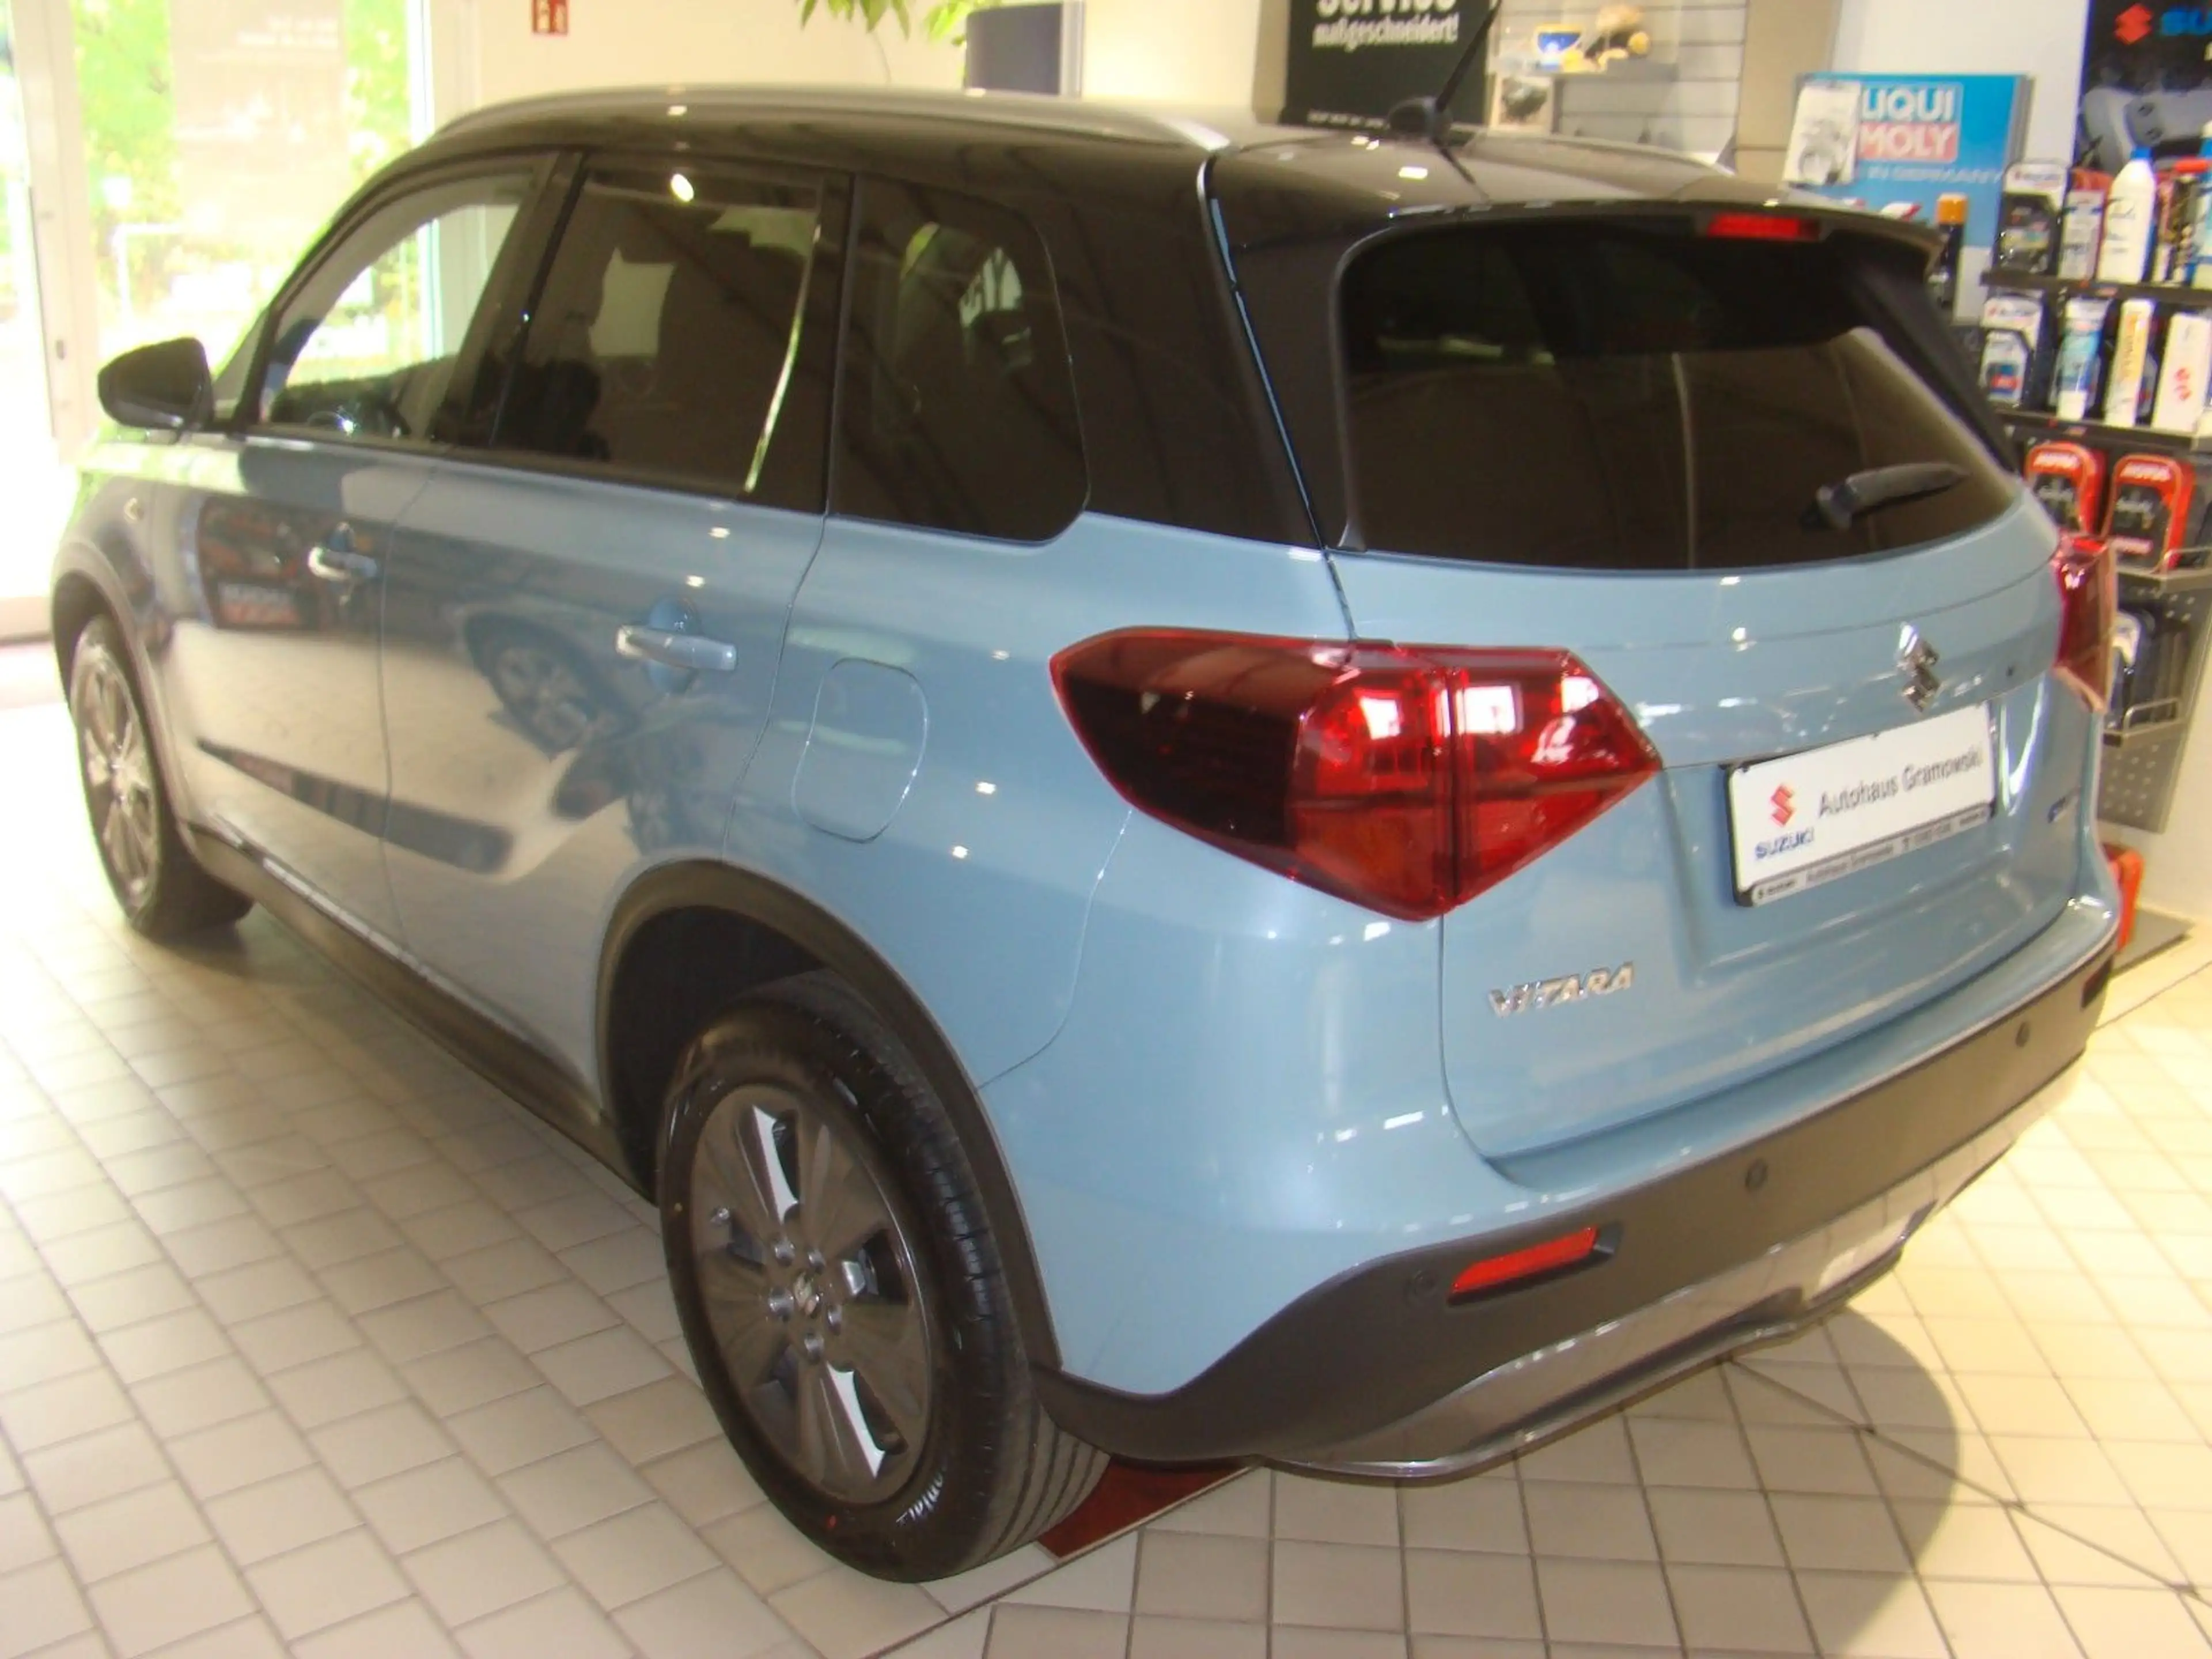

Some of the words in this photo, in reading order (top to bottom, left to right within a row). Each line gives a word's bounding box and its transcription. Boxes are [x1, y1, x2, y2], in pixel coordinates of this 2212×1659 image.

[1861, 86, 1955, 123] LIQUI
[1859, 123, 1956, 157] MOLY
[1819, 776, 1898, 817] Autohaus
[1755, 827, 1814, 859] SUZUKI
[1488, 960, 1634, 1018] VITARA
